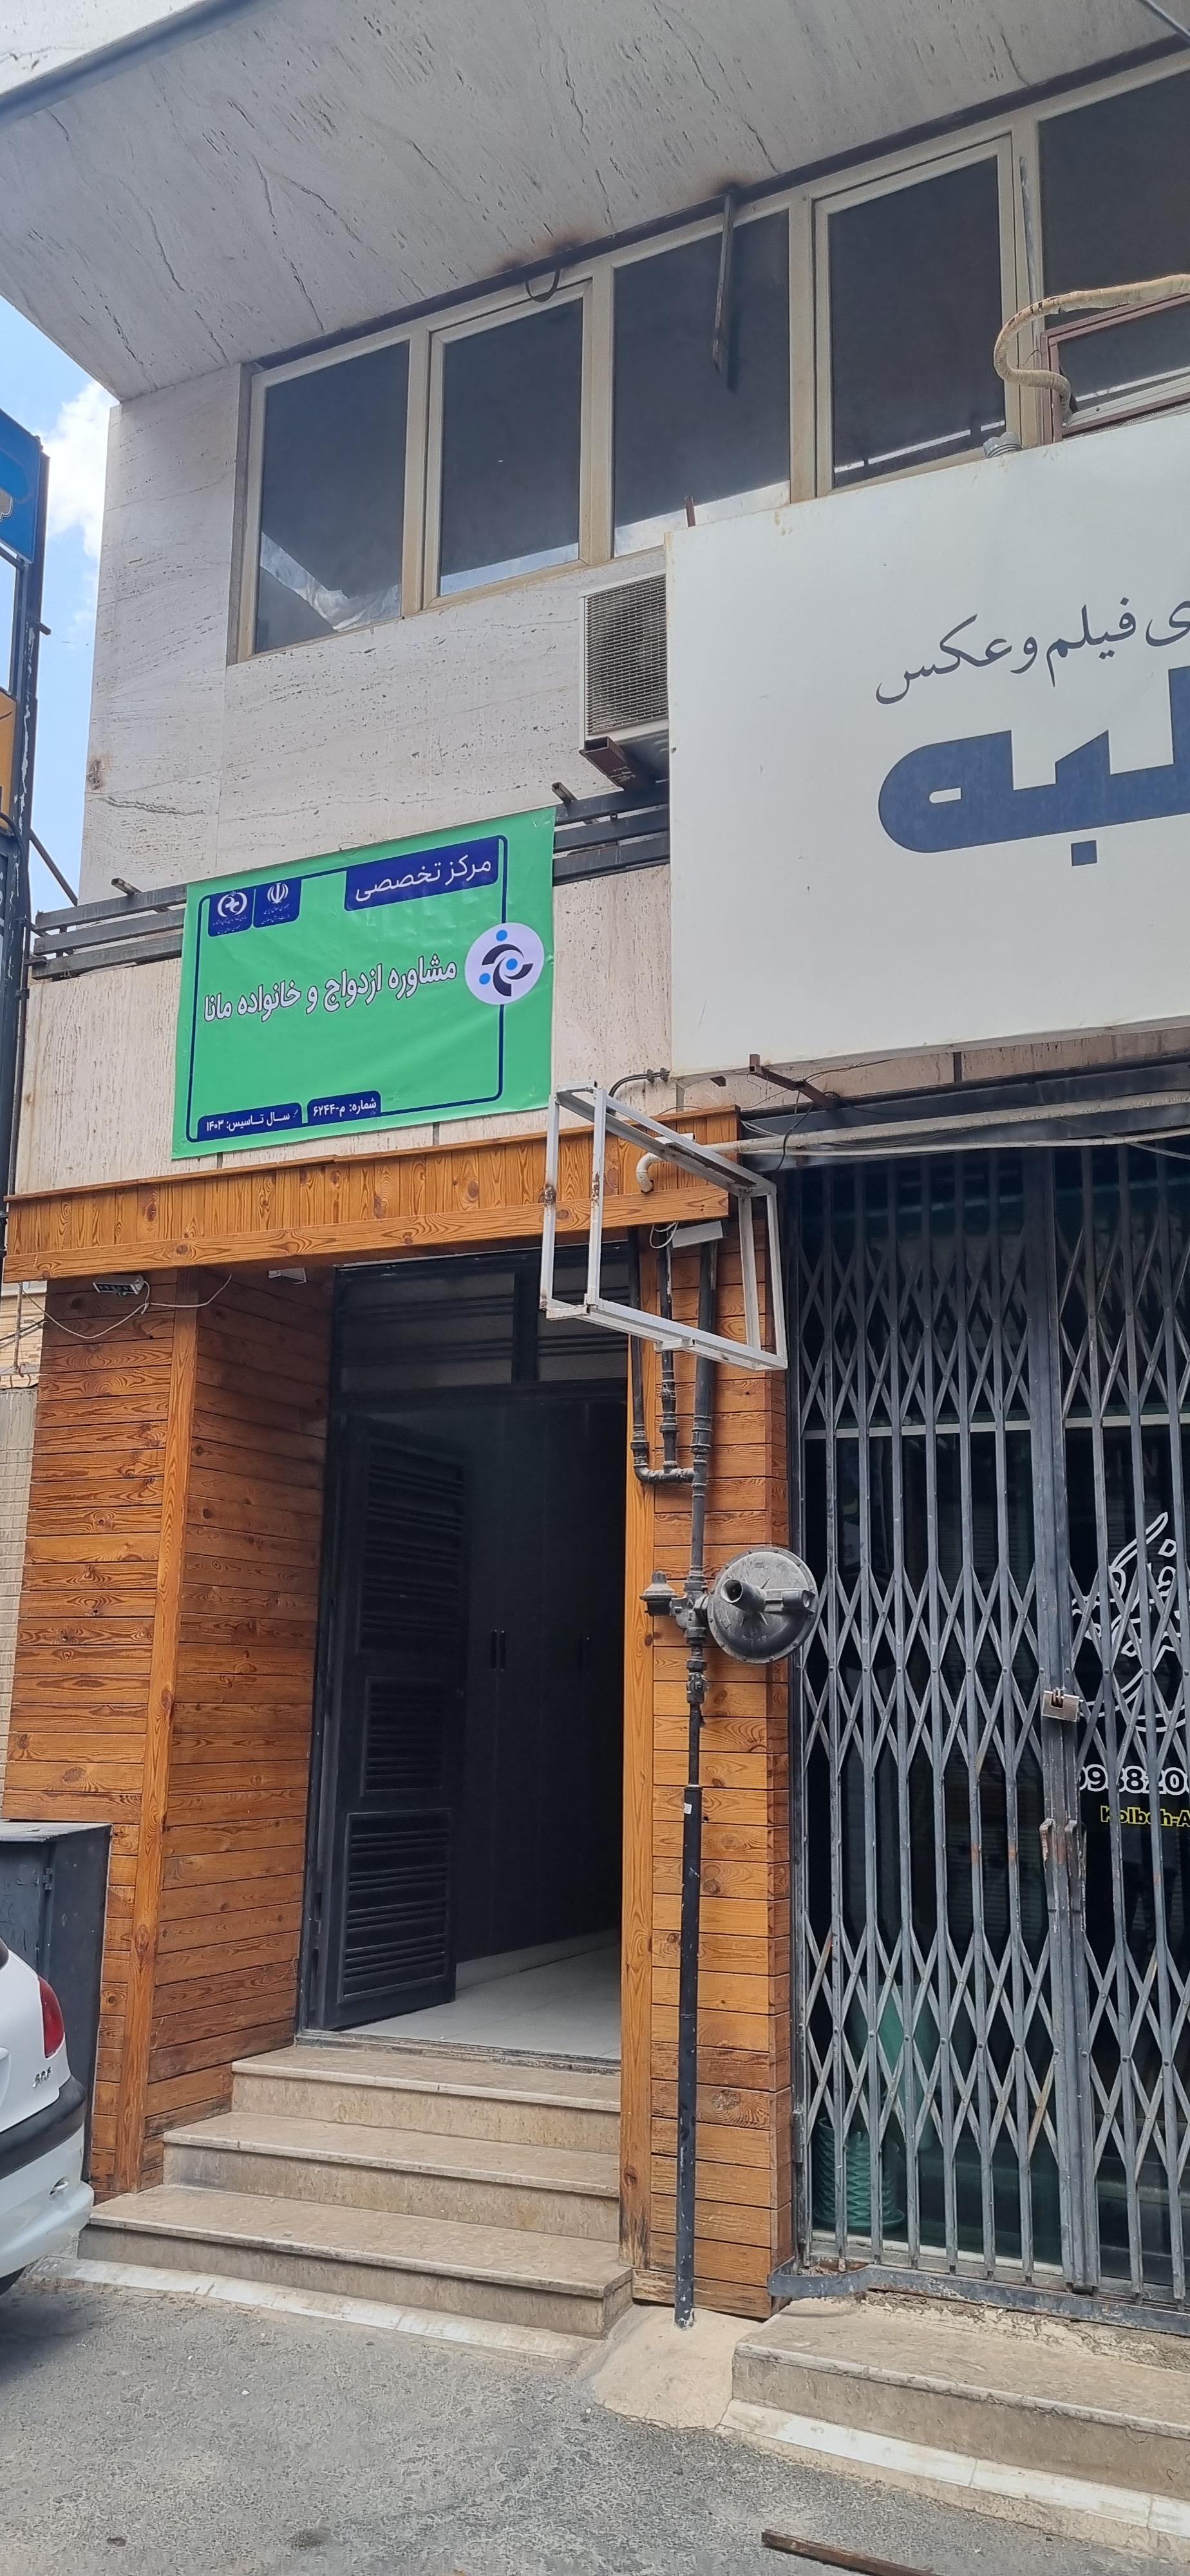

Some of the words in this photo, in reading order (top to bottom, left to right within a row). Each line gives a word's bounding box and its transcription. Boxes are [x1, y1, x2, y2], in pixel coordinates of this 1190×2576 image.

[876, 614, 1013, 705] عکس
[1010, 636, 1038, 674] و
[1046, 596, 1137, 688] فیلم
[355, 861, 442, 902] تخصصی
[444, 854, 491, 886] مرکز
[323, 962, 382, 1012] ازدواج
[388, 953, 457, 1000] مشاوره
[203, 992, 233, 1022] مانا
[237, 980, 302, 1023] خانواده
[305, 985, 319, 1015] و
[266, 1112, 290, 1126] سال
[349, 1097, 377, 1115] شماره:
[206, 1119, 224, 1132] ۱۴۰۳
